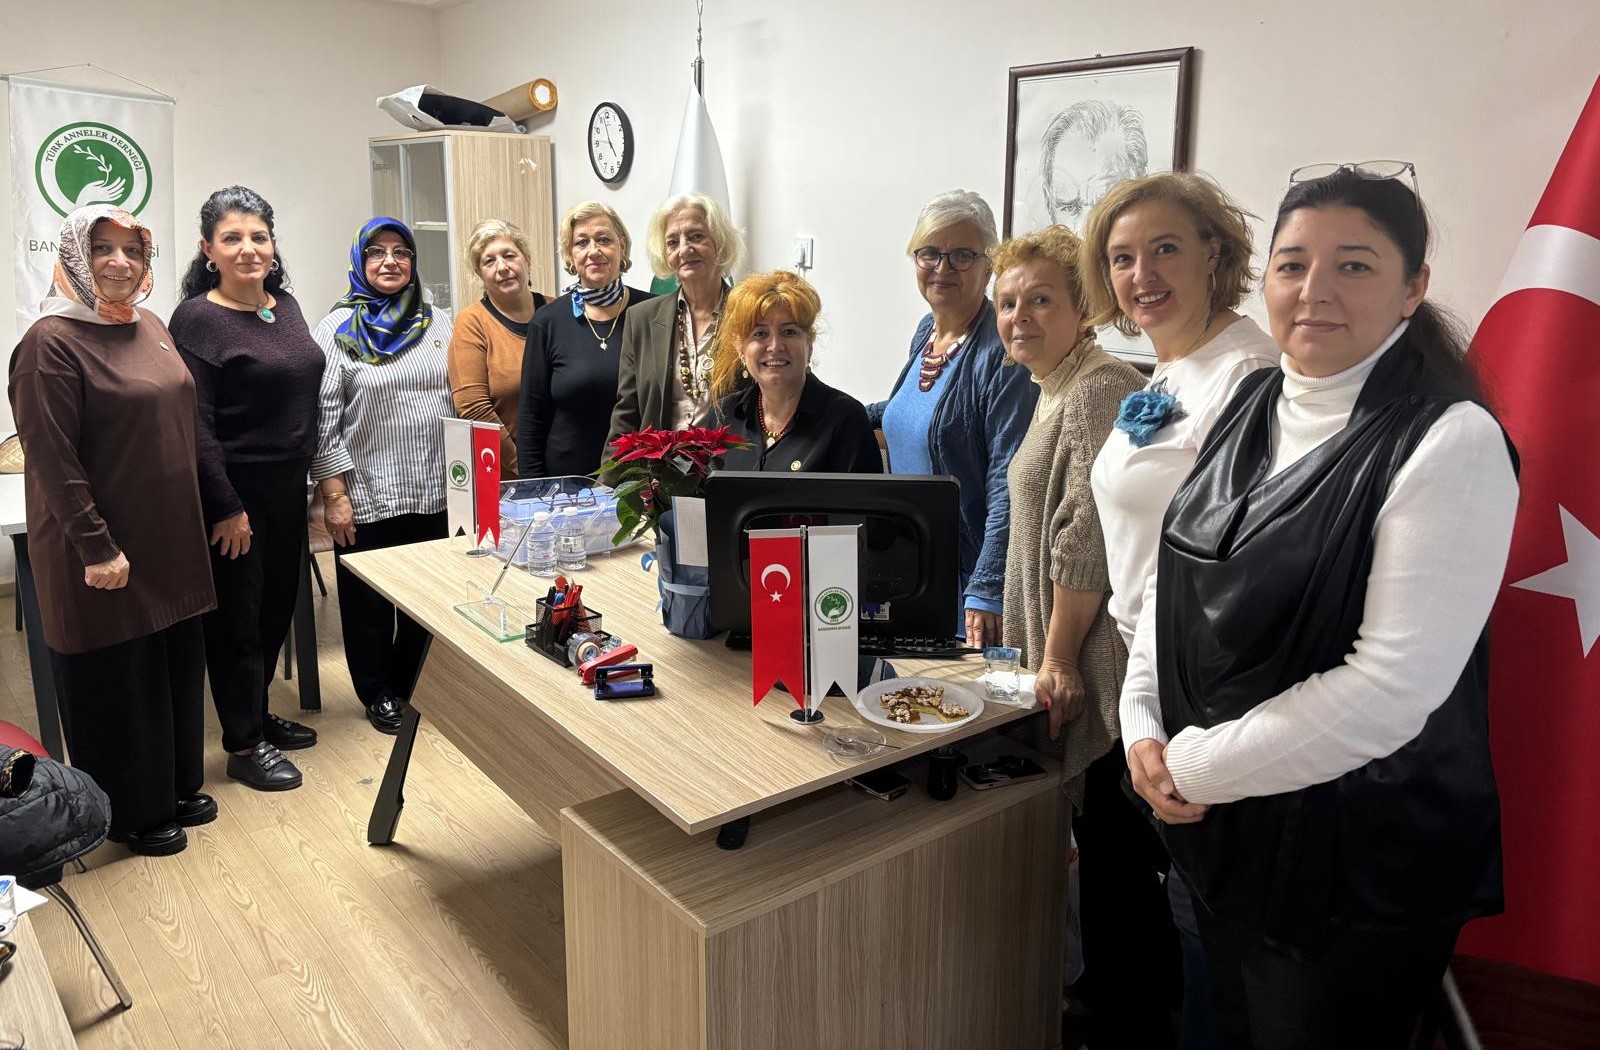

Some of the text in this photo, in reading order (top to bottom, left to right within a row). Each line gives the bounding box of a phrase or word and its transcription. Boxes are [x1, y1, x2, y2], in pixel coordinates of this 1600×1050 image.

[45, 129, 145, 171] TÜRK ANNELER DERNEĞİ
